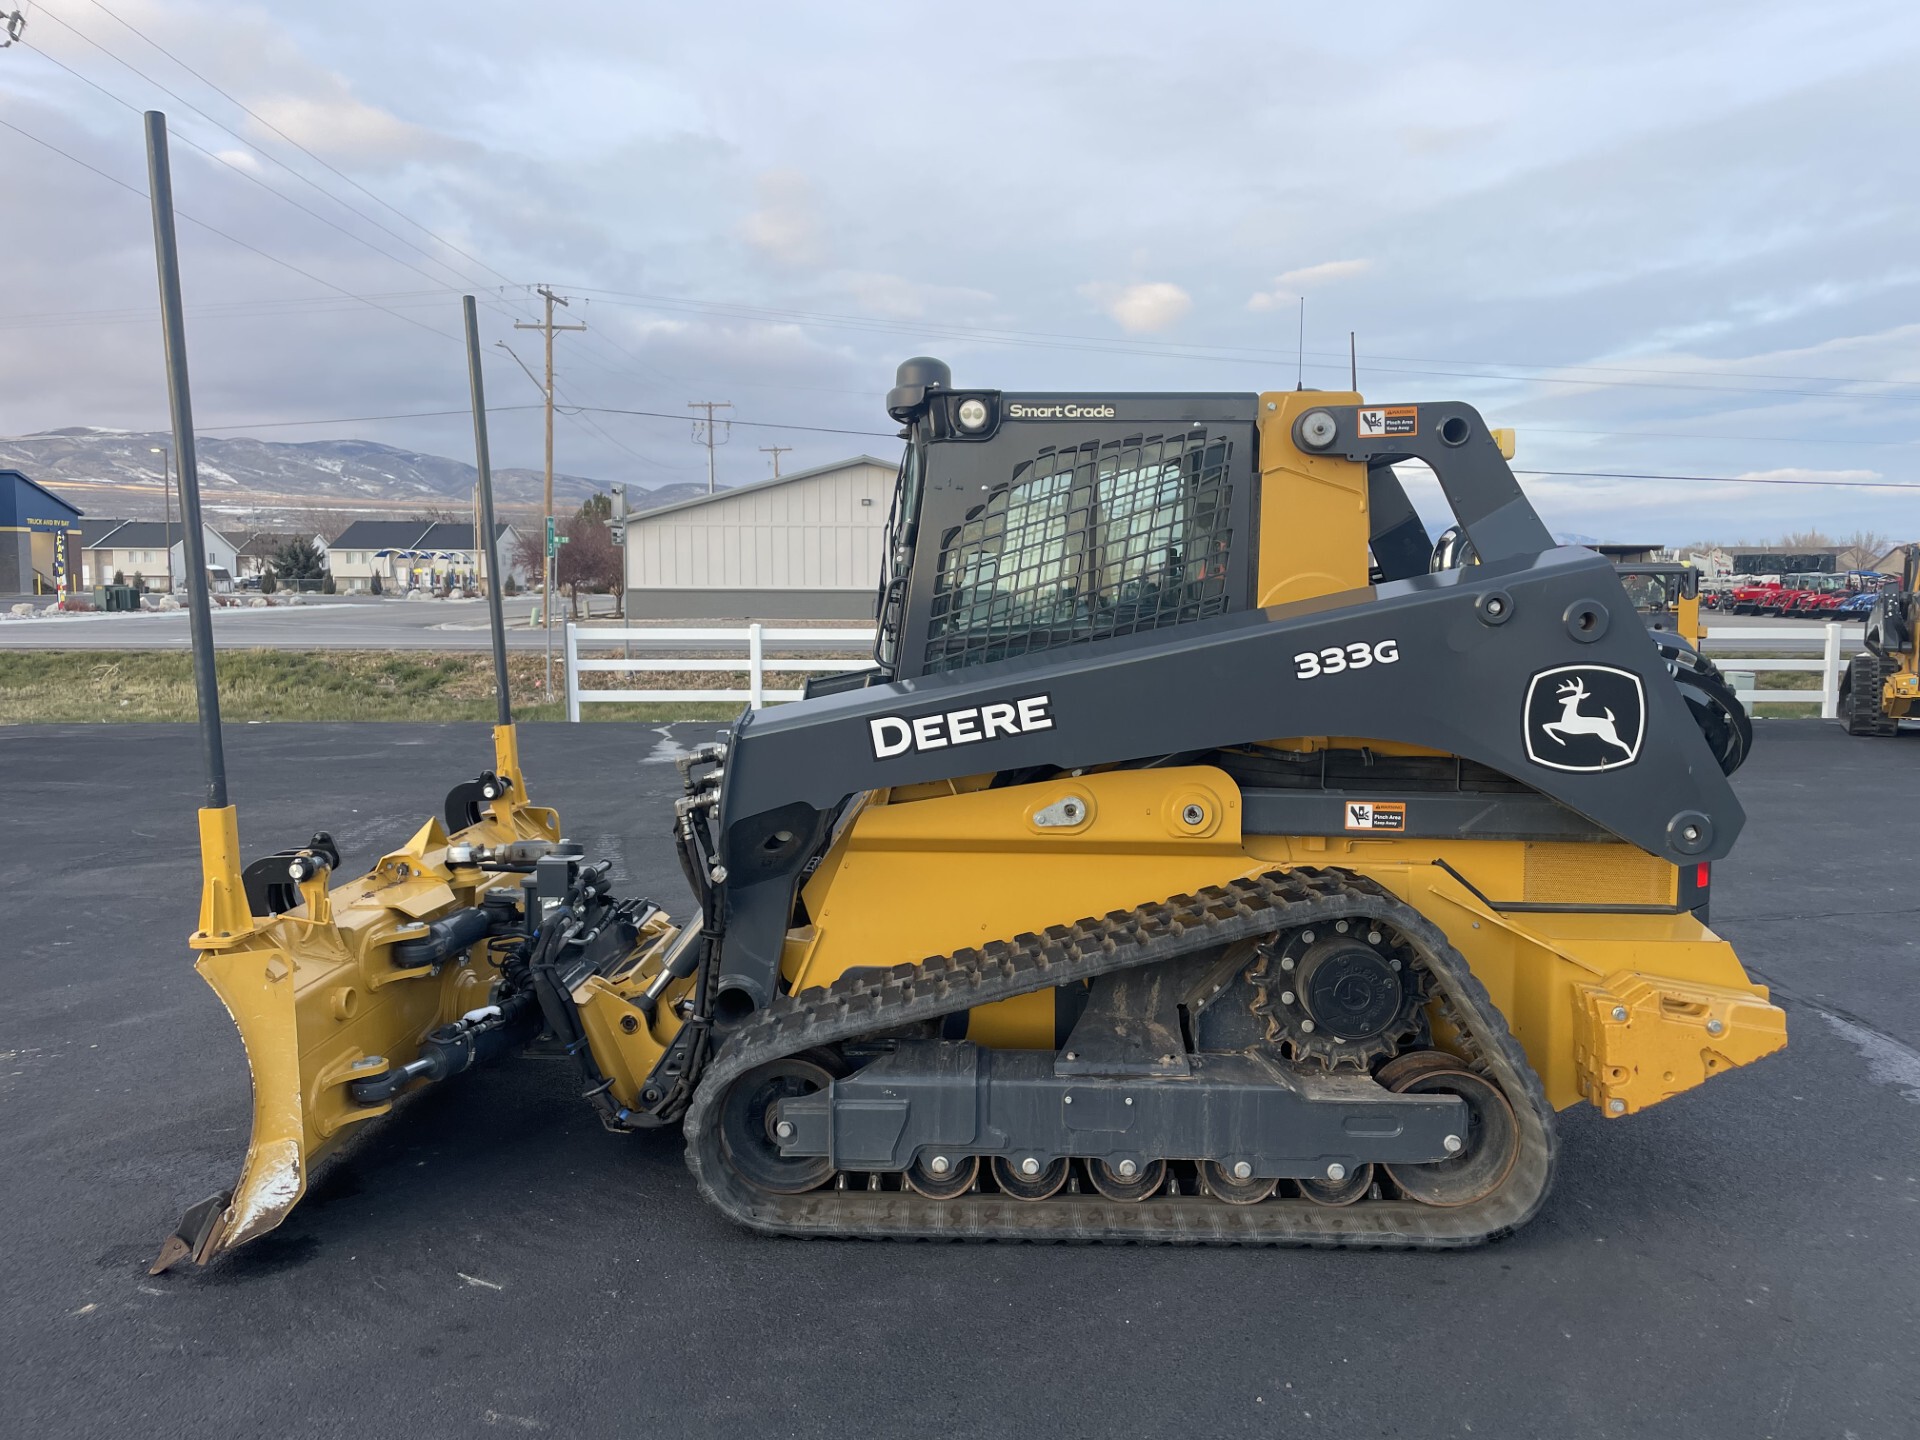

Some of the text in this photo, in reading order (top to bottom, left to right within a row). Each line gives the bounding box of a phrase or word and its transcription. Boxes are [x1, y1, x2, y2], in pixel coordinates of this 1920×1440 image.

[26, 517, 42, 525] TRUCK
[1294, 640, 1399, 679] 333G
[870, 695, 1052, 758] DEERE
